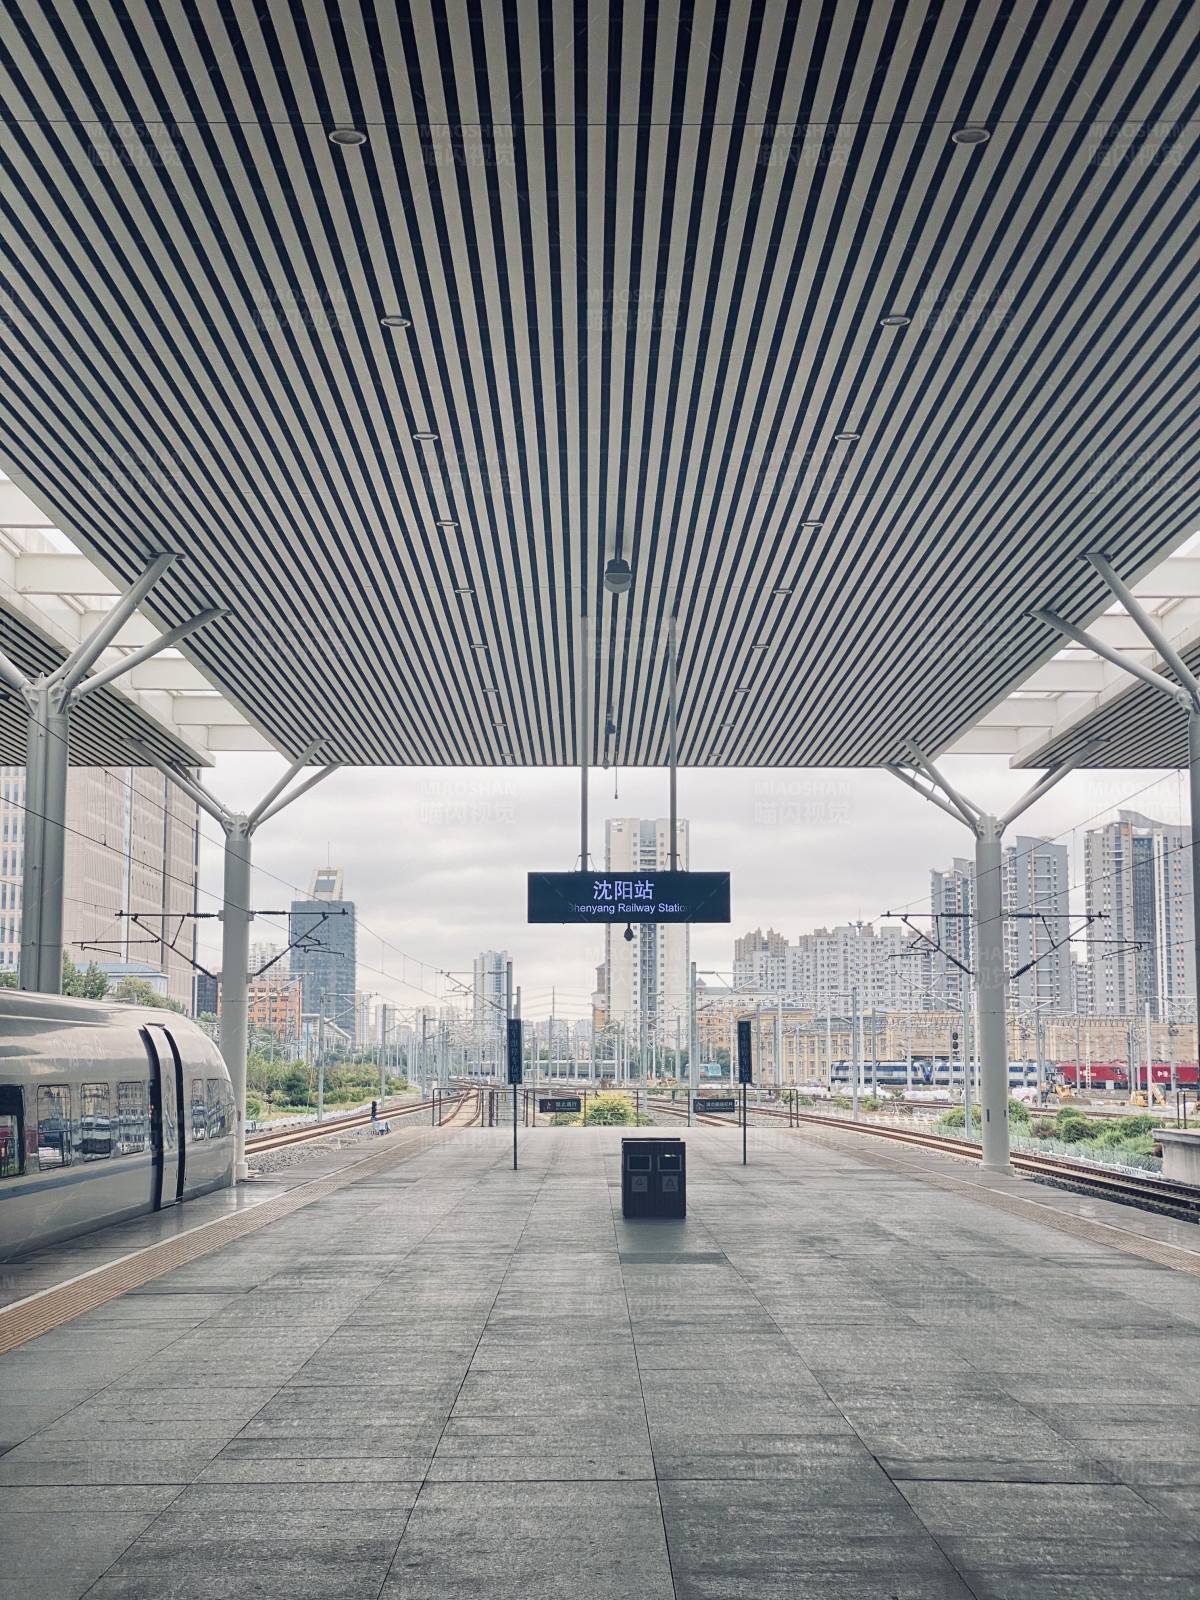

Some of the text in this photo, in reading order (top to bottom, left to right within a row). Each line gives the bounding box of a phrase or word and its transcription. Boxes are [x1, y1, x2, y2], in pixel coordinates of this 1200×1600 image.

[593, 880, 655, 900] 沈阳站
[618, 903, 656, 915] Railway
[658, 903, 688, 913] Statio
